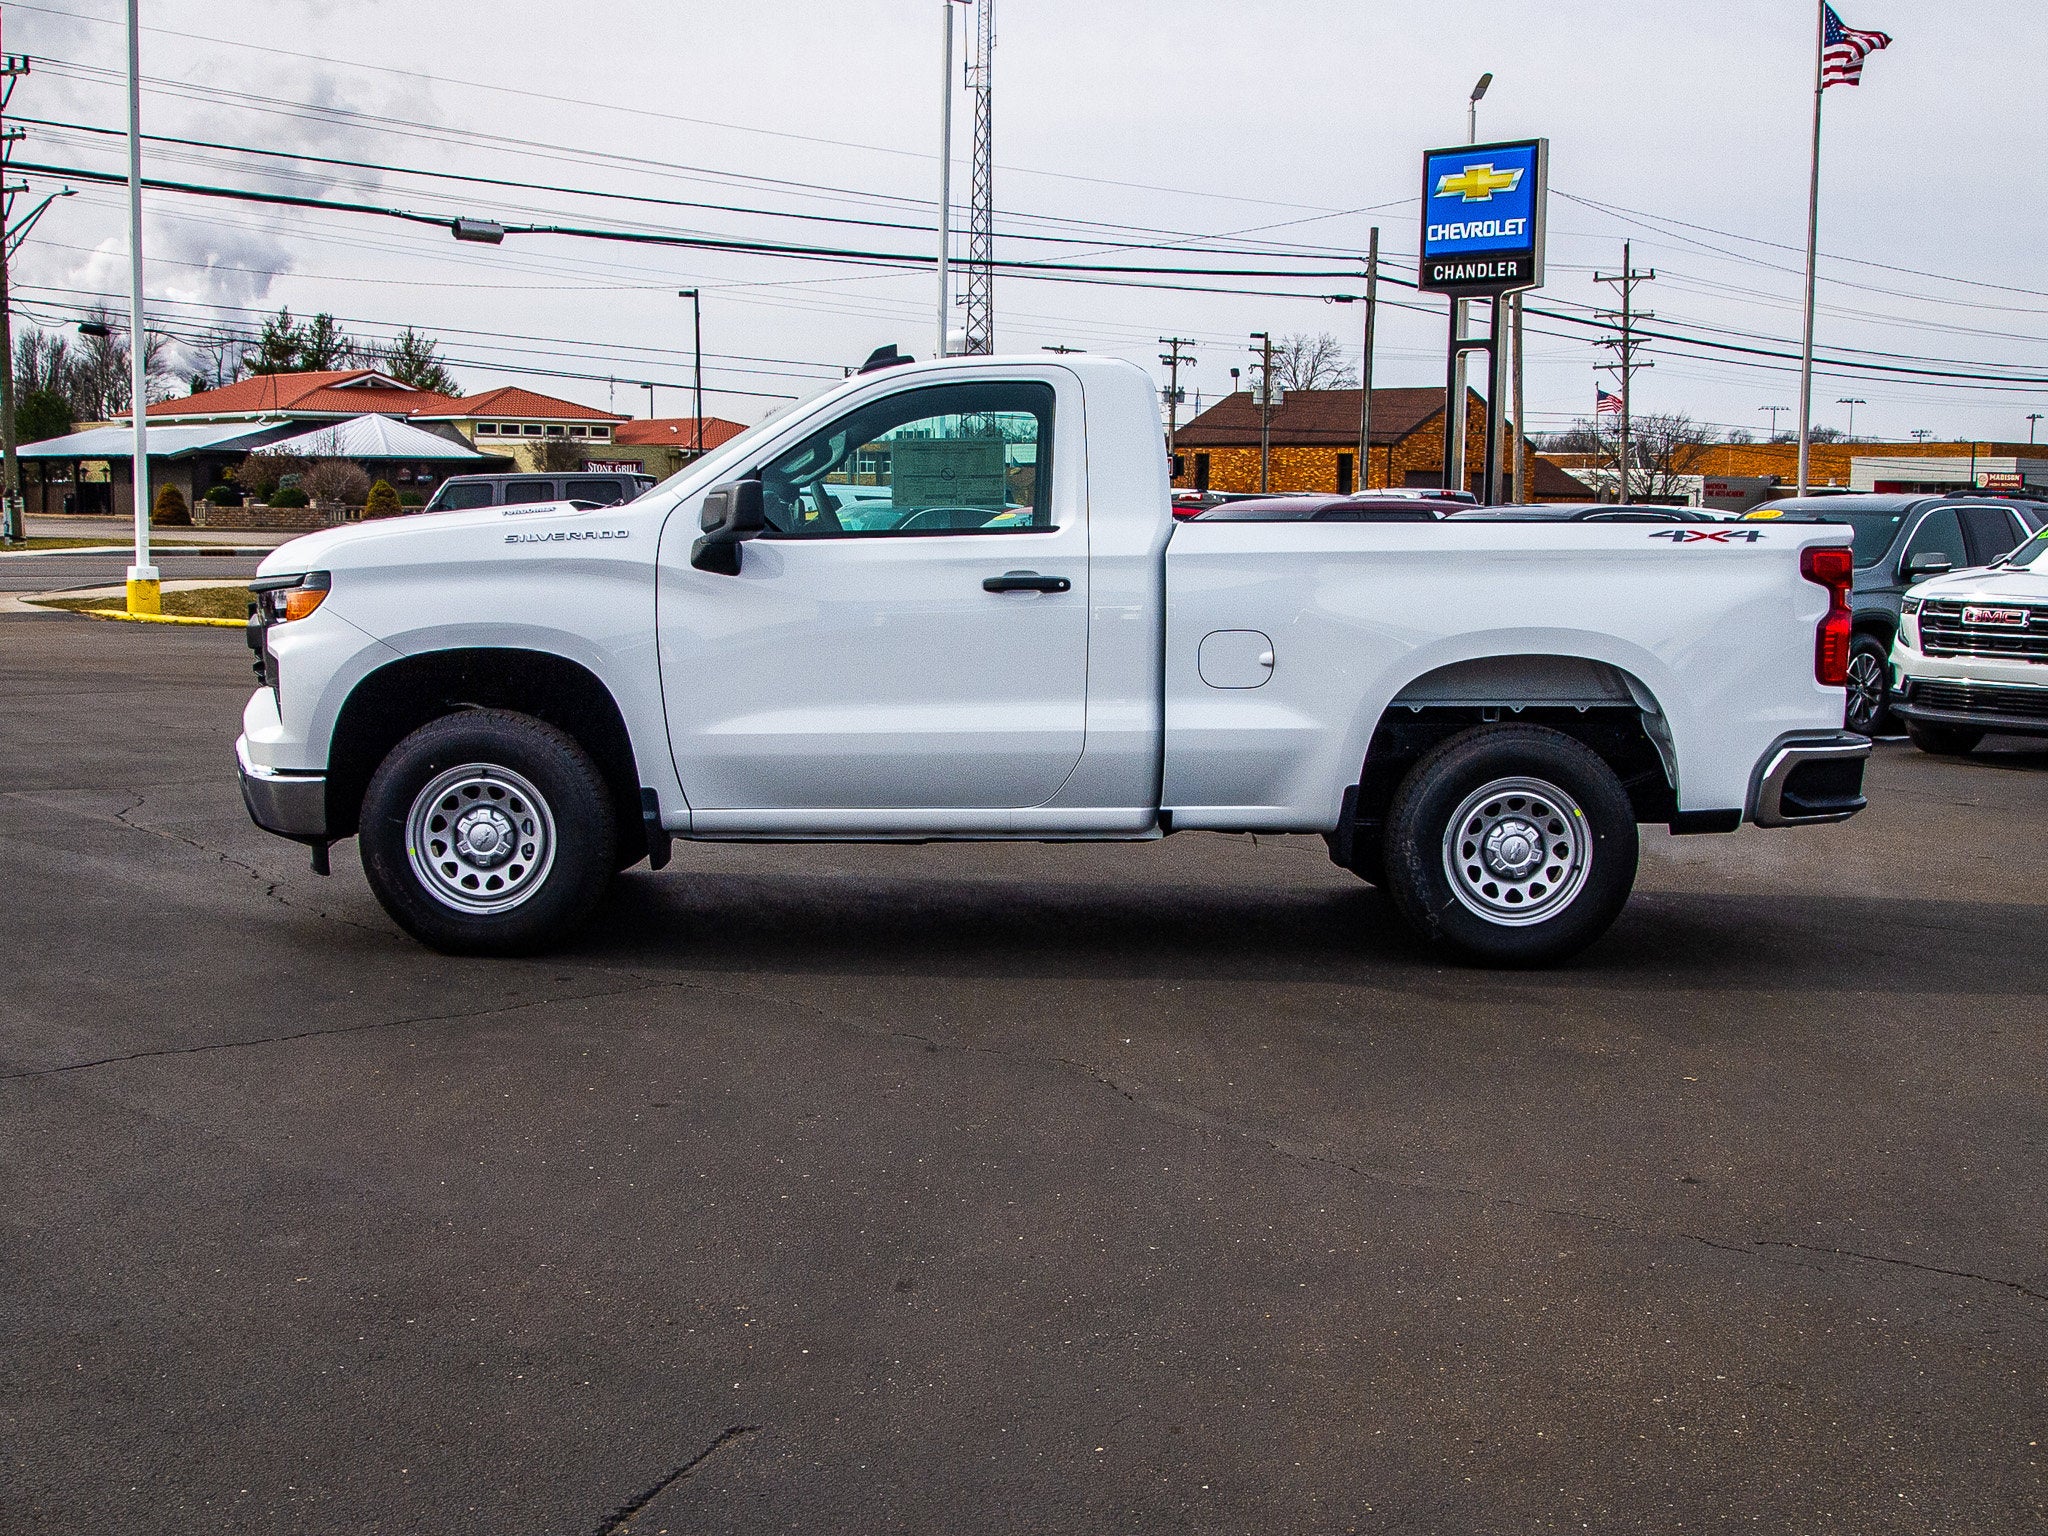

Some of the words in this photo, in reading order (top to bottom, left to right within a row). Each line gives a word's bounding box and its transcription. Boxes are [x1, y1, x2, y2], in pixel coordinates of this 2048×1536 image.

[1427, 218, 1527, 241] CHEVROLET
[1433, 261, 1518, 280] CHANDLER
[587, 461, 613, 472] STONE
[615, 463, 638, 473] GRILL
[504, 530, 630, 544] SILVERADO
[1964, 610, 2022, 624] GMC
